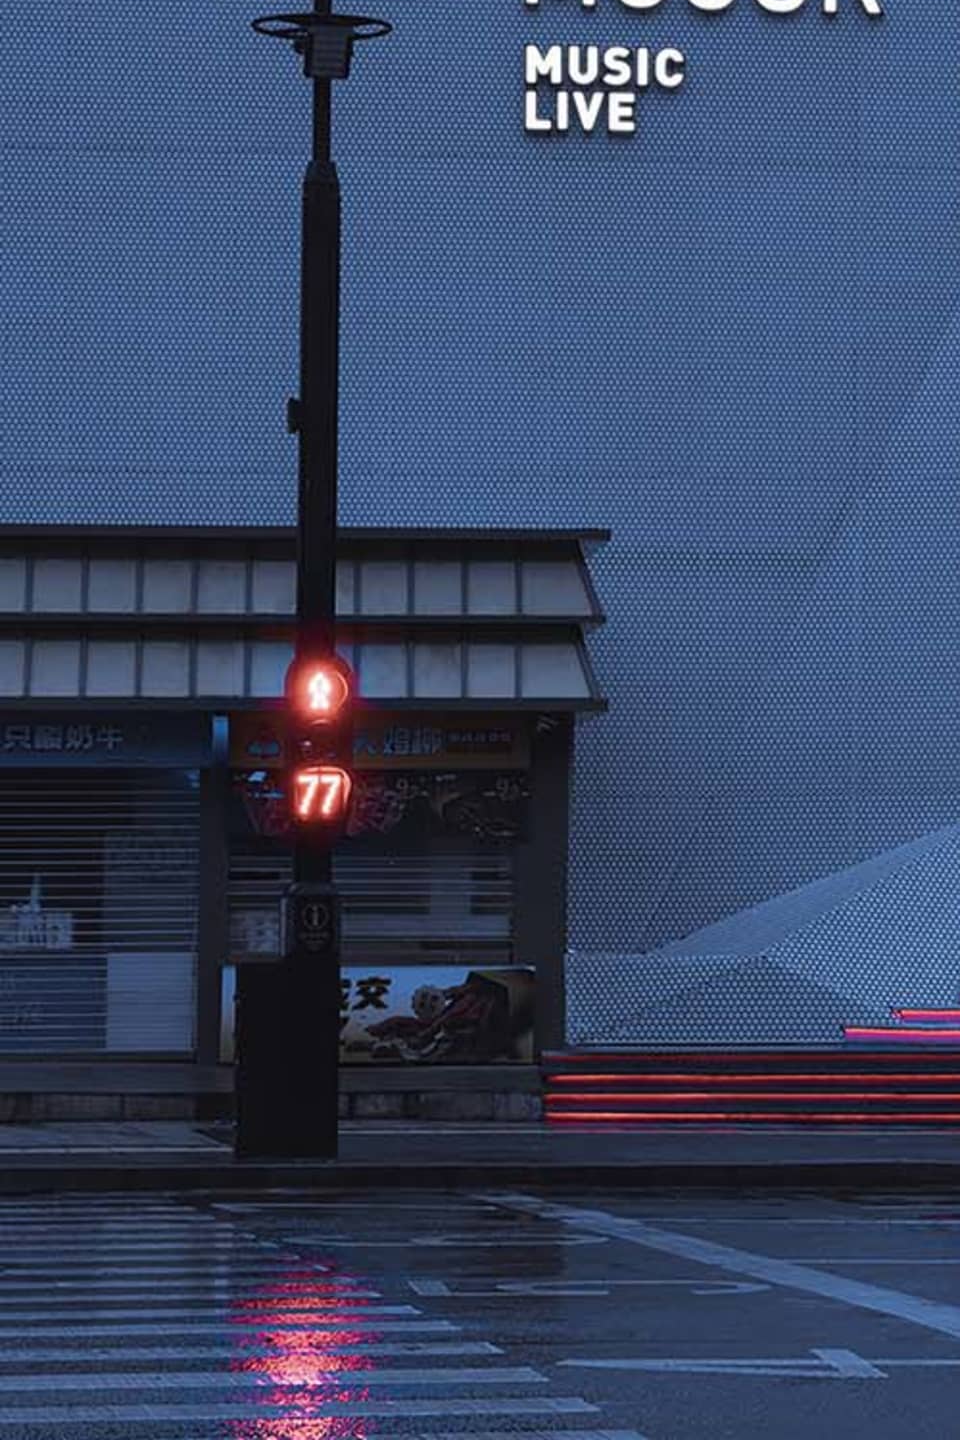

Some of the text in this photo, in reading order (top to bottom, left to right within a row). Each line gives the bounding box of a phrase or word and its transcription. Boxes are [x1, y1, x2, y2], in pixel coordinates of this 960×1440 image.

[525, 45, 684, 87] MUSIC
[525, 91, 636, 132] LIVE
[297, 774, 341, 817] 77
